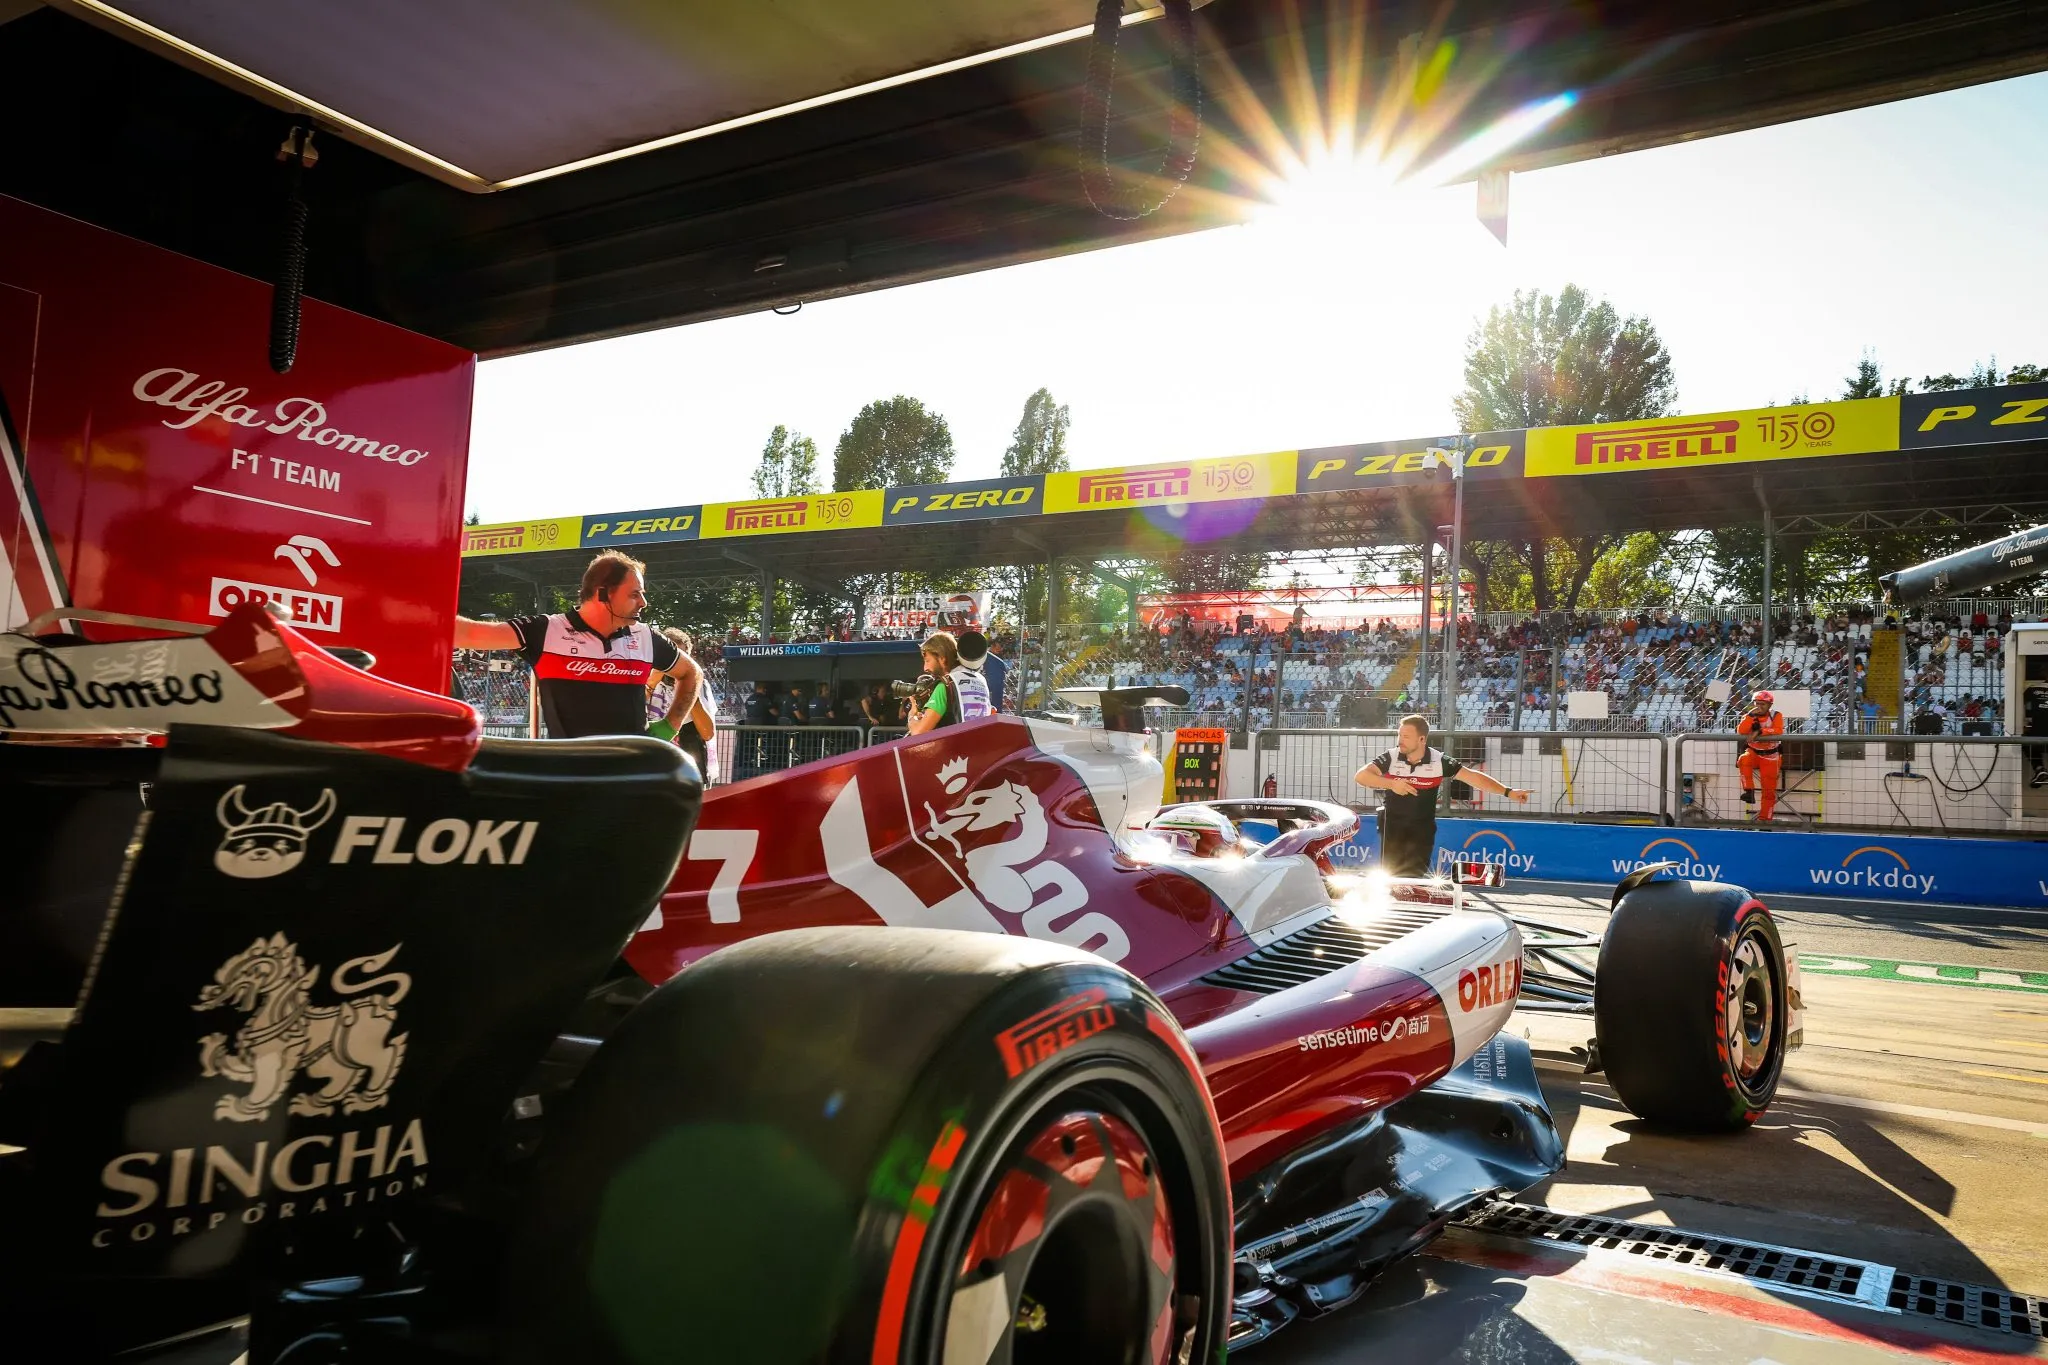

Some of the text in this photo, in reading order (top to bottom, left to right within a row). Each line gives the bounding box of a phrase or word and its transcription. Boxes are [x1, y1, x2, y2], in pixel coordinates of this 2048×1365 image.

[133, 367, 429, 467] Alfa Romeo
[1917, 405, 1976, 432] P
[1575, 411, 1835, 465] PIRELLI 150
[1804, 440, 1832, 448] YEARS
[270, 457, 341, 492] TEAM
[1078, 461, 1254, 503] PIRELLI 150
[1308, 458, 1347, 480] P
[726, 498, 853, 530] PIRELLI 150
[890, 487, 1035, 515] P ZERO
[461, 523, 559, 551] PIRELLI 150
[587, 515, 695, 538] P ZERO
[1992, 540, 2015, 563] Alfa
[2010, 554, 2034, 568] F1 TEAM
[881, 597, 940, 611] CHARLES
[739, 645, 821, 656] WILLIAMS RACING
[16, 647, 223, 710] Romeo
[566, 660, 643, 676] Alfa Romeo
[1178, 731, 1222, 739] NICHOLAS
[1184, 758, 1200, 768] BOX
[330, 815, 540, 865] FLOKI
[1441, 847, 1536, 872] workday
[1612, 856, 1720, 882] wokday
[1810, 866, 1935, 895] workday
[1458, 956, 1522, 1013] ORLEN
[1715, 960, 1728, 1064] ZERO
[994, 986, 1117, 1080] PIRELLI
[1298, 1025, 1378, 1051] sensetime
[96, 1118, 429, 1218] SINGHA
[92, 1172, 429, 1249] CORPORATION
